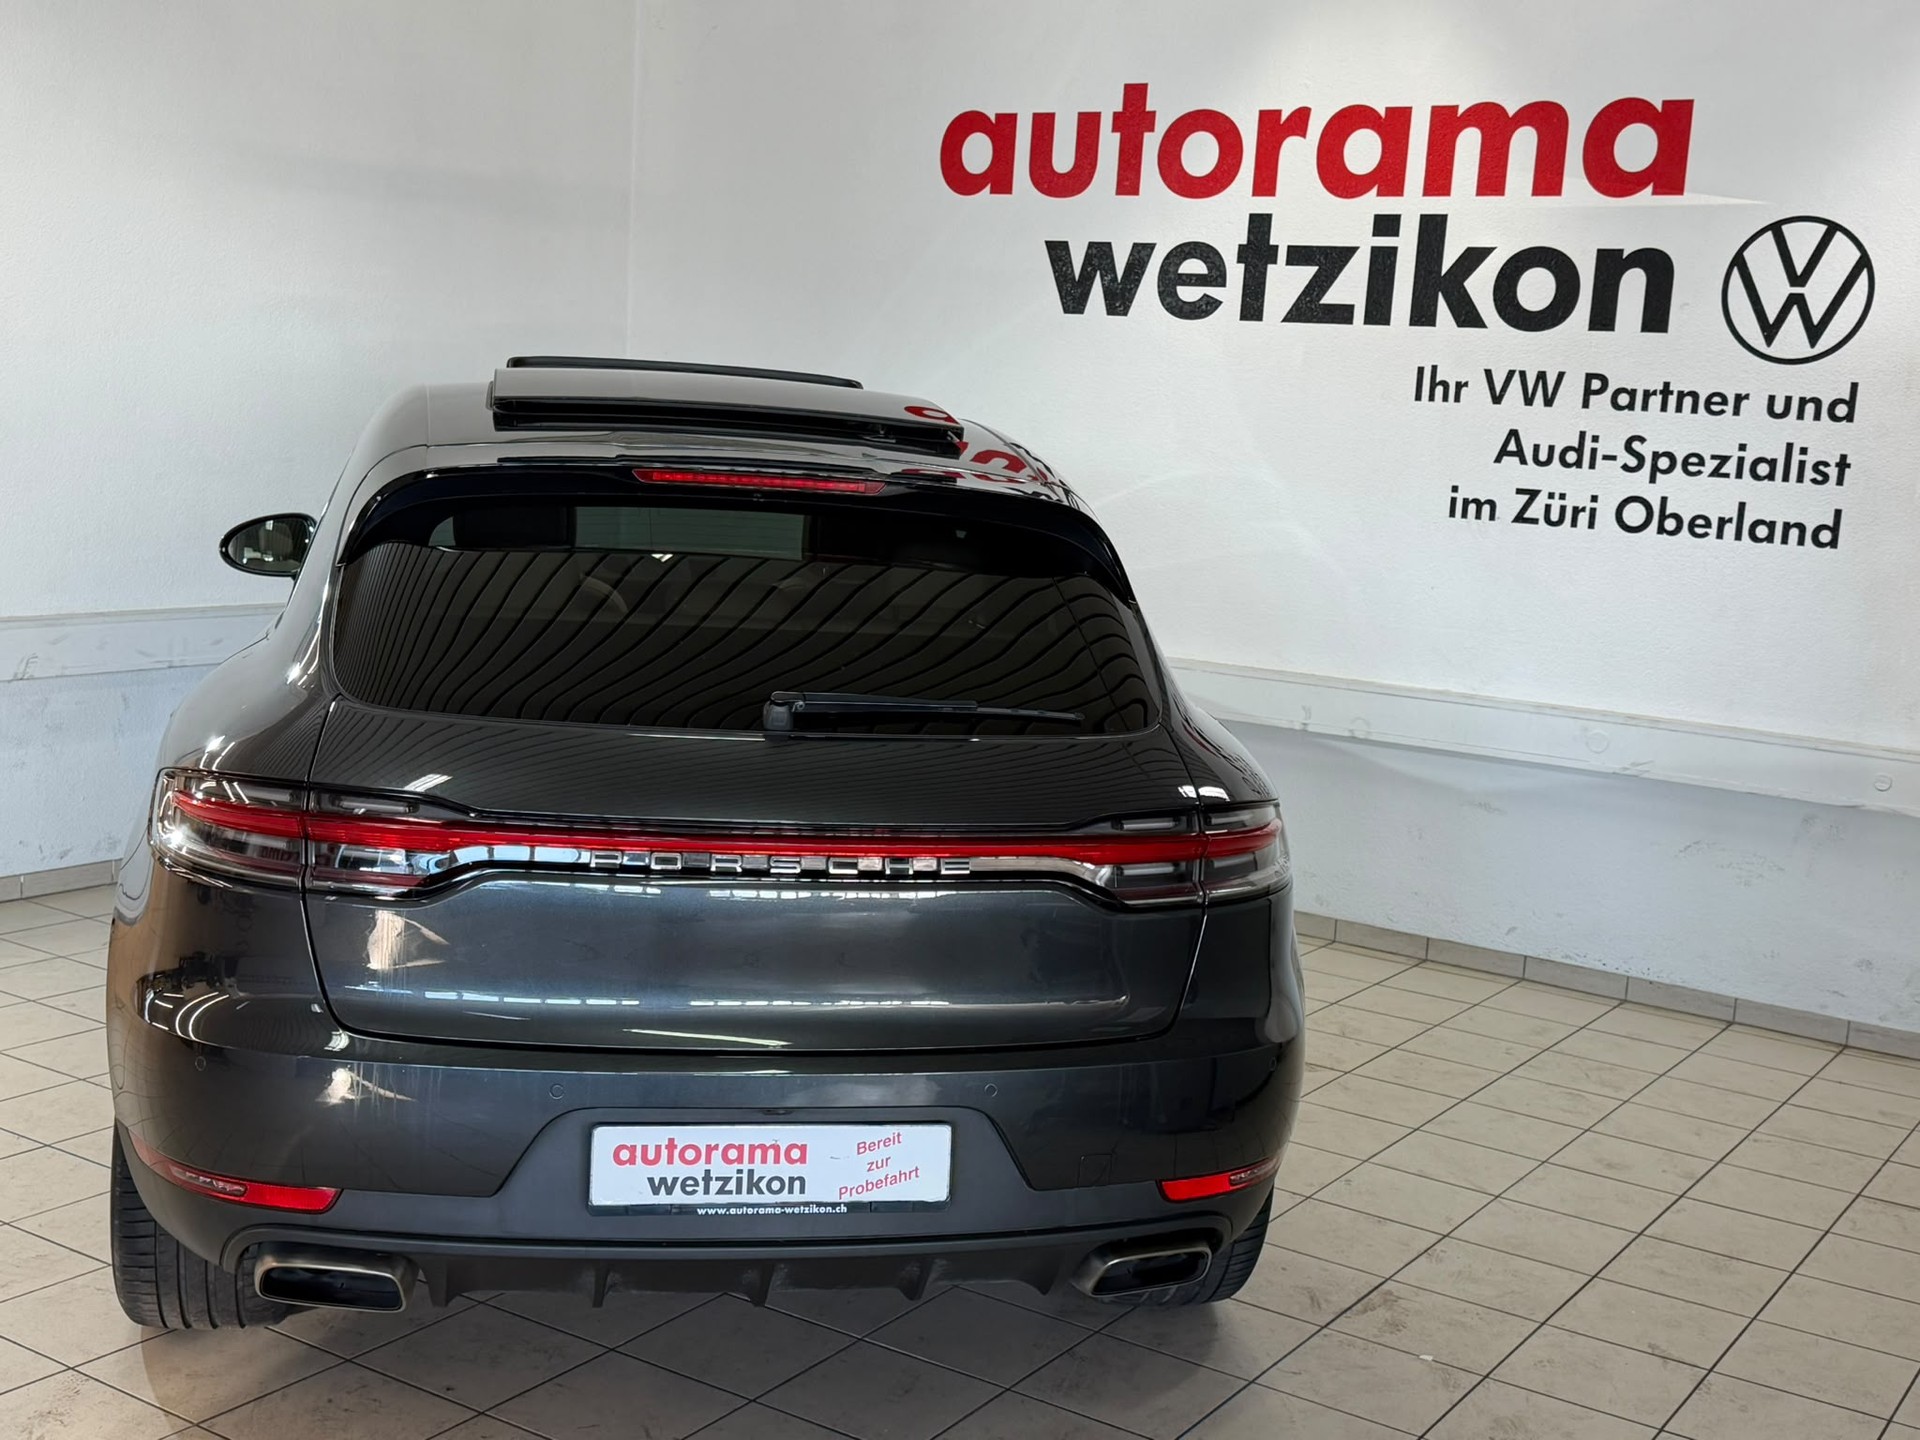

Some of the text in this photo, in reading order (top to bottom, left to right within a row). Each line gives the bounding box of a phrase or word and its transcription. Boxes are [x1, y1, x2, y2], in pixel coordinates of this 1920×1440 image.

[940, 83, 1695, 199] autorama
[1044, 213, 1675, 334] wetzikon
[1414, 364, 1859, 423] Ihr VW Partner und
[1493, 428, 1852, 487] Audi-Spezialist
[1448, 487, 1843, 550] im Züri Oberland
[590, 850, 971, 875] PORSCHE
[612, 1137, 808, 1167] autorama
[856, 1131, 902, 1155] Bereit
[866, 1156, 891, 1172] zur
[647, 1169, 806, 1196] wetzikon
[838, 1165, 920, 1200] Probefahrt
[697, 1203, 848, 1216] www.autorama-wetzikon.ch
